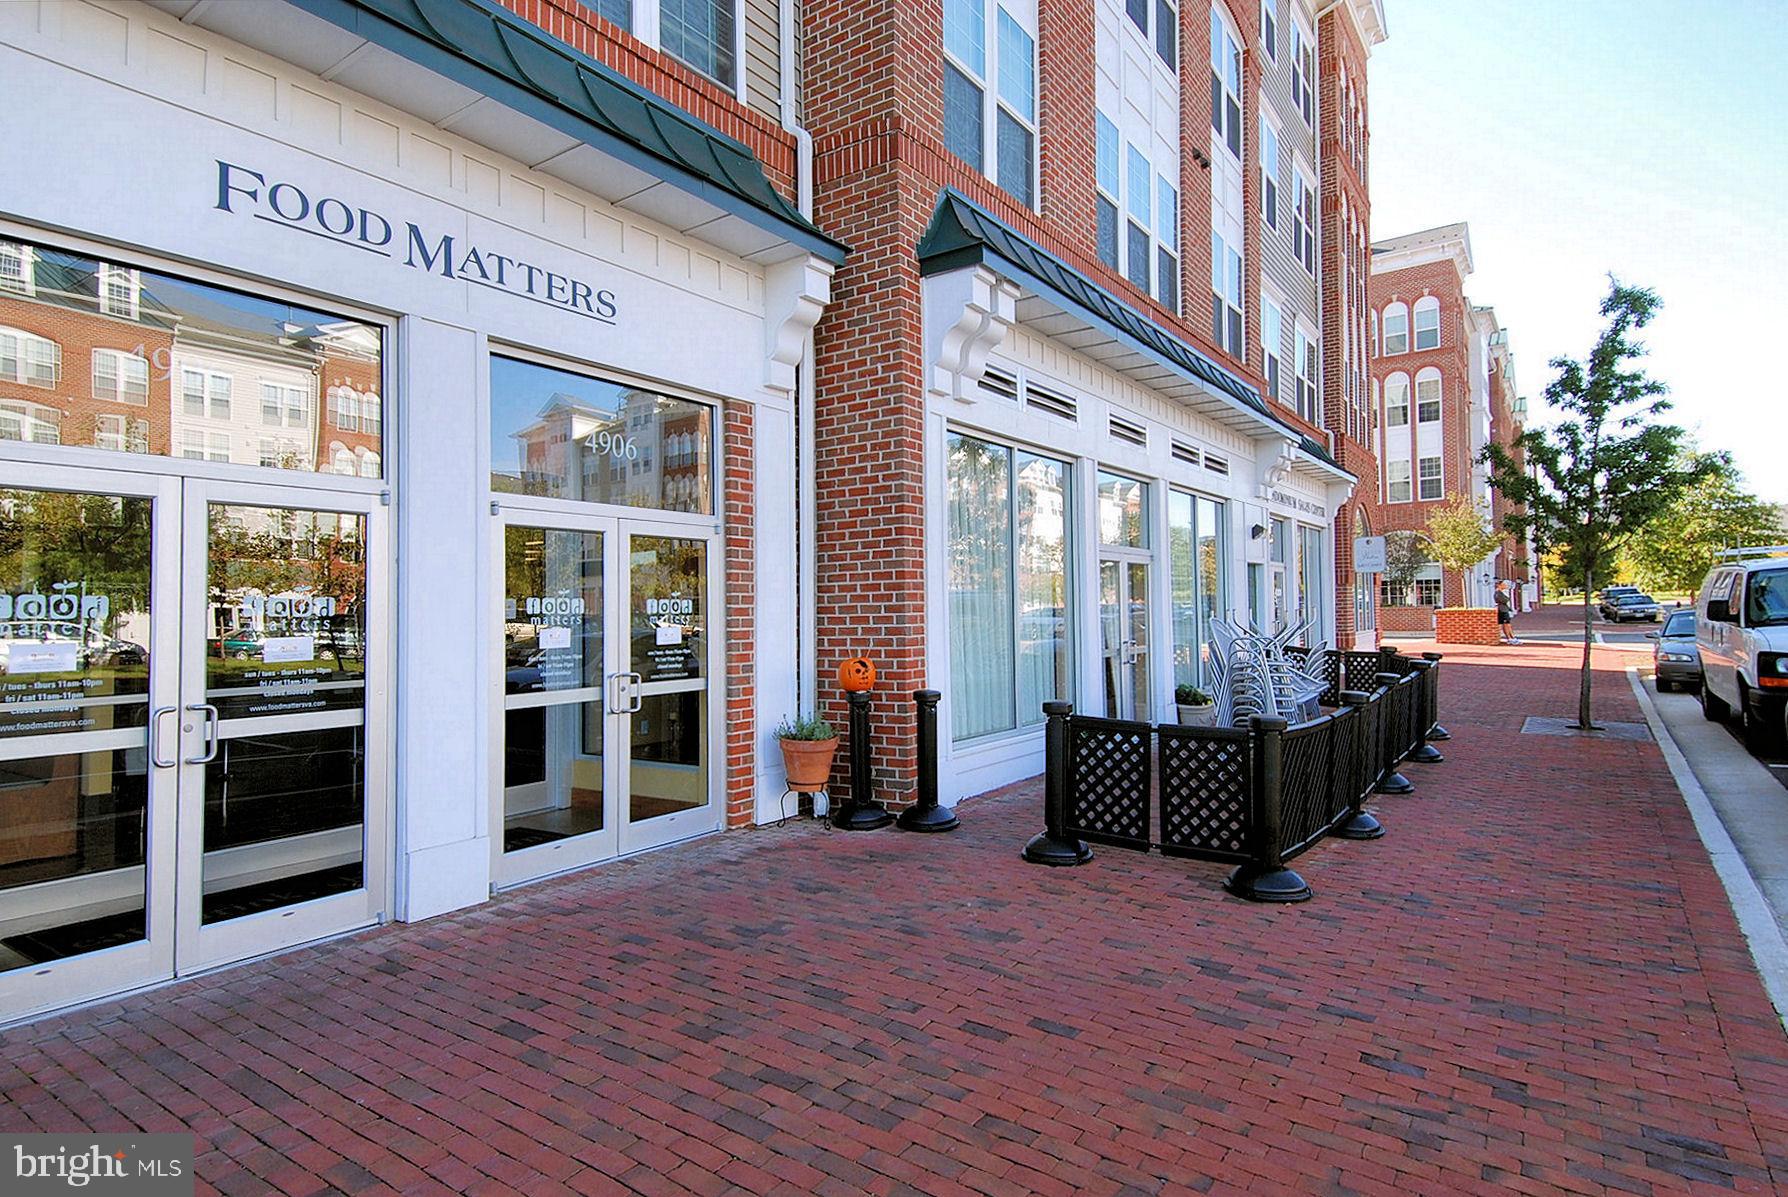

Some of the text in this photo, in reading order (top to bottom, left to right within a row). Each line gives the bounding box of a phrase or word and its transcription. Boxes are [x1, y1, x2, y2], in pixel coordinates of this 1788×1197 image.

[213, 159, 618, 319] FOOD MATTERS
[584, 431, 637, 460] 4906
[0, 591, 110, 620] ood
[34, 681, 56, 690] thurs
[58, 679, 104, 688] 11am-10pm
[0, 718, 96, 732] ww.foodmattersva.com
